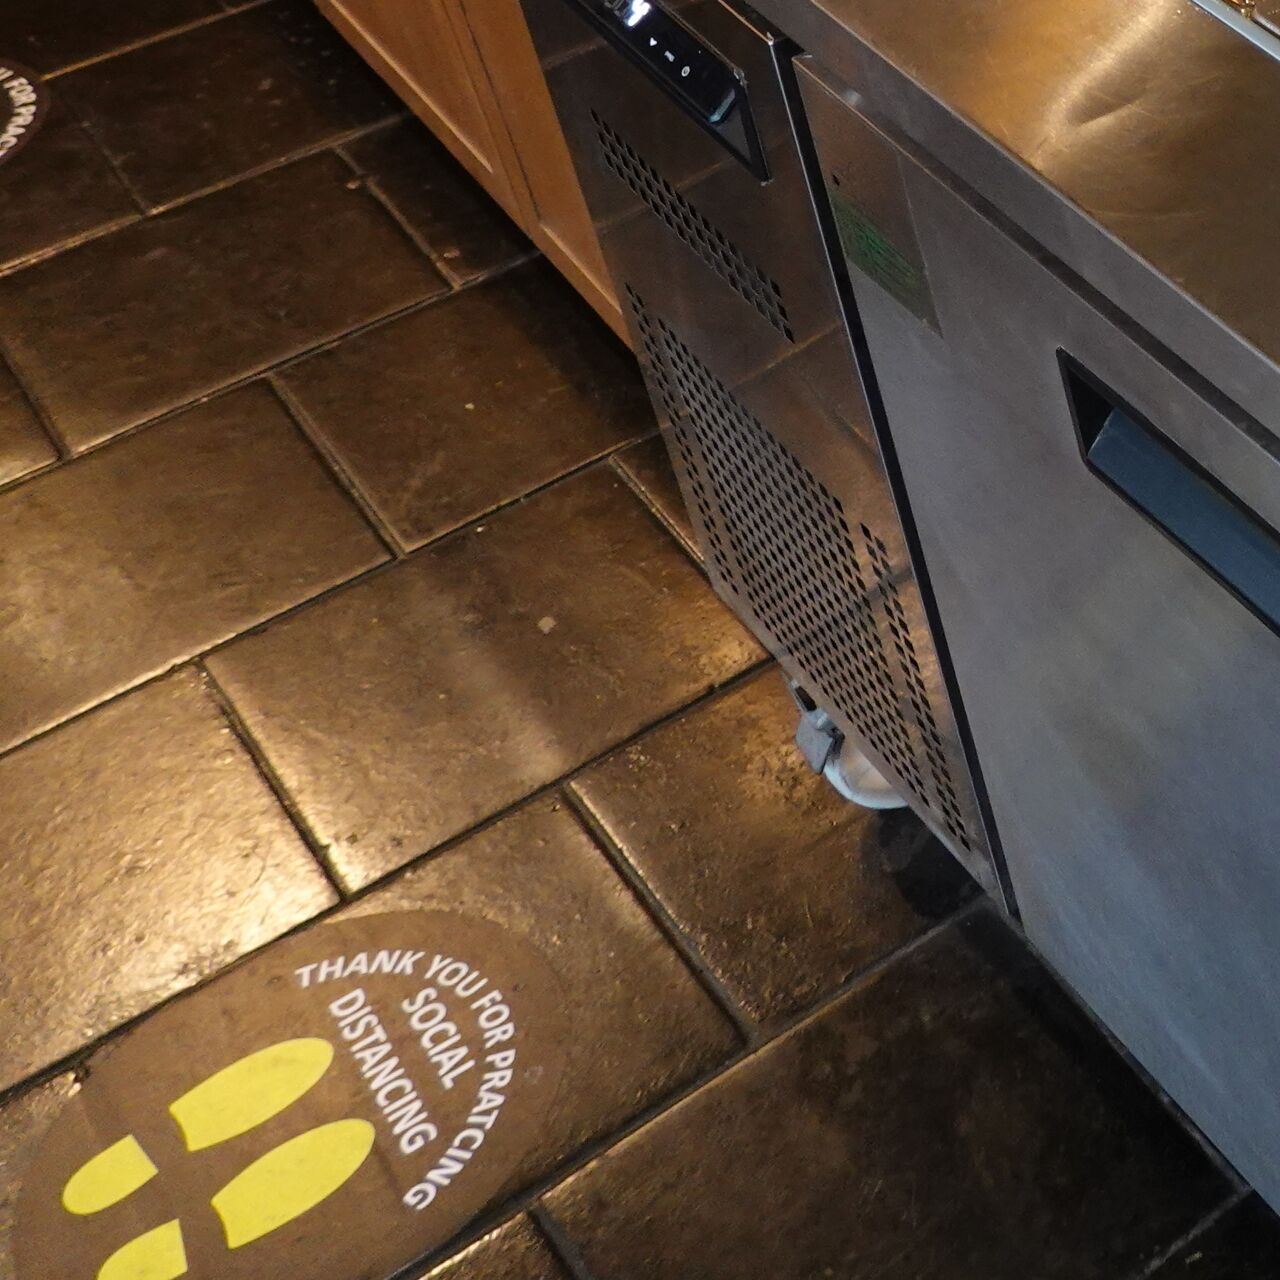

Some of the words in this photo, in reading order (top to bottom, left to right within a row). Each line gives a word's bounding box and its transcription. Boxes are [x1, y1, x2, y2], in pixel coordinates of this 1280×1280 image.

[294, 949, 426, 989] THANK
[424, 953, 489, 999] YOU
[401, 986, 476, 1091] SOCIAL
[469, 988, 515, 1050] FOR
[328, 986, 439, 1155] DISTANCING
[402, 1047, 517, 1211] PRATCING
